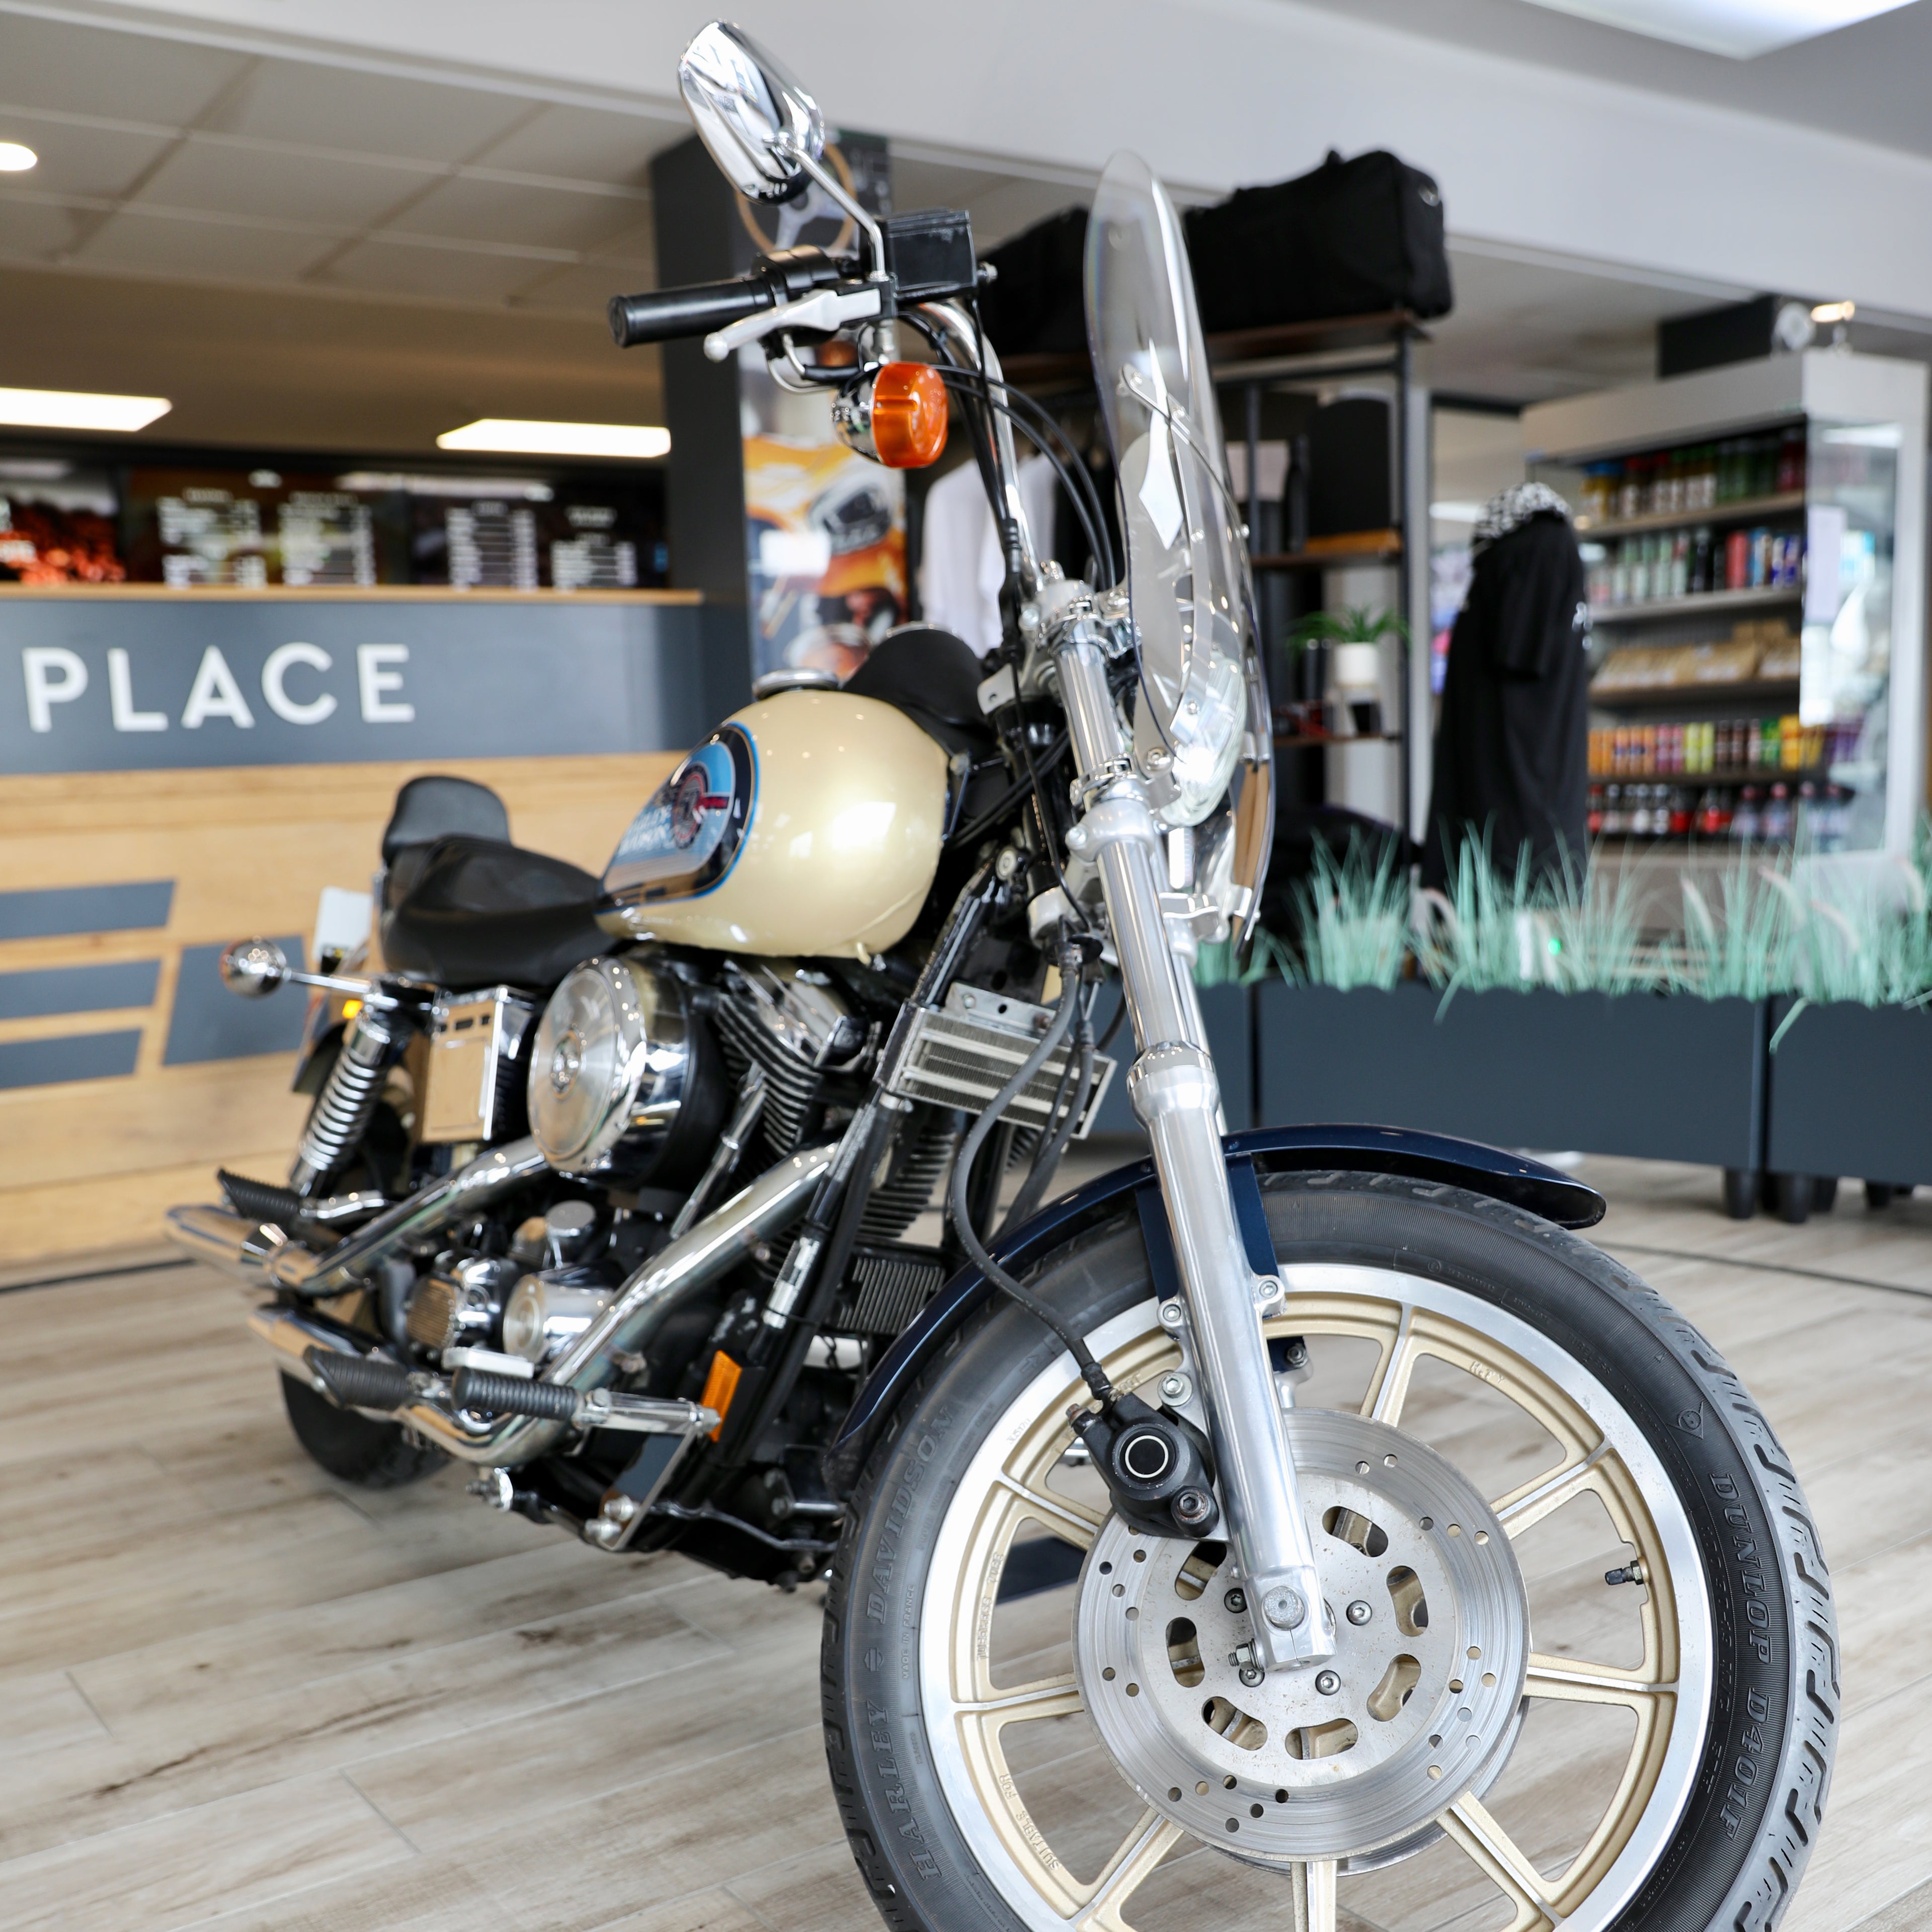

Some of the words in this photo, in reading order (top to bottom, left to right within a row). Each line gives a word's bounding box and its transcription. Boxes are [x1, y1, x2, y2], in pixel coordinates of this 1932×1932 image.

[22, 641, 415, 733] PLACE
[1566, 1333, 1612, 1375] TUBELESS
[865, 1405, 953, 1624] DAVIDSON
[1710, 1473, 1773, 1664] DUNLOP
[902, 1584, 915, 1627] FRANCE
[977, 1596, 993, 1660] TUBELESS
[901, 1649, 909, 1679] MADE
[902, 1632, 910, 1644] IN
[863, 1699, 942, 1881] HARLEY
[997, 1772, 1017, 1801] FOR
[1719, 1686, 1772, 1840] D401F
[1014, 1809, 1062, 1873] SUITABLE
